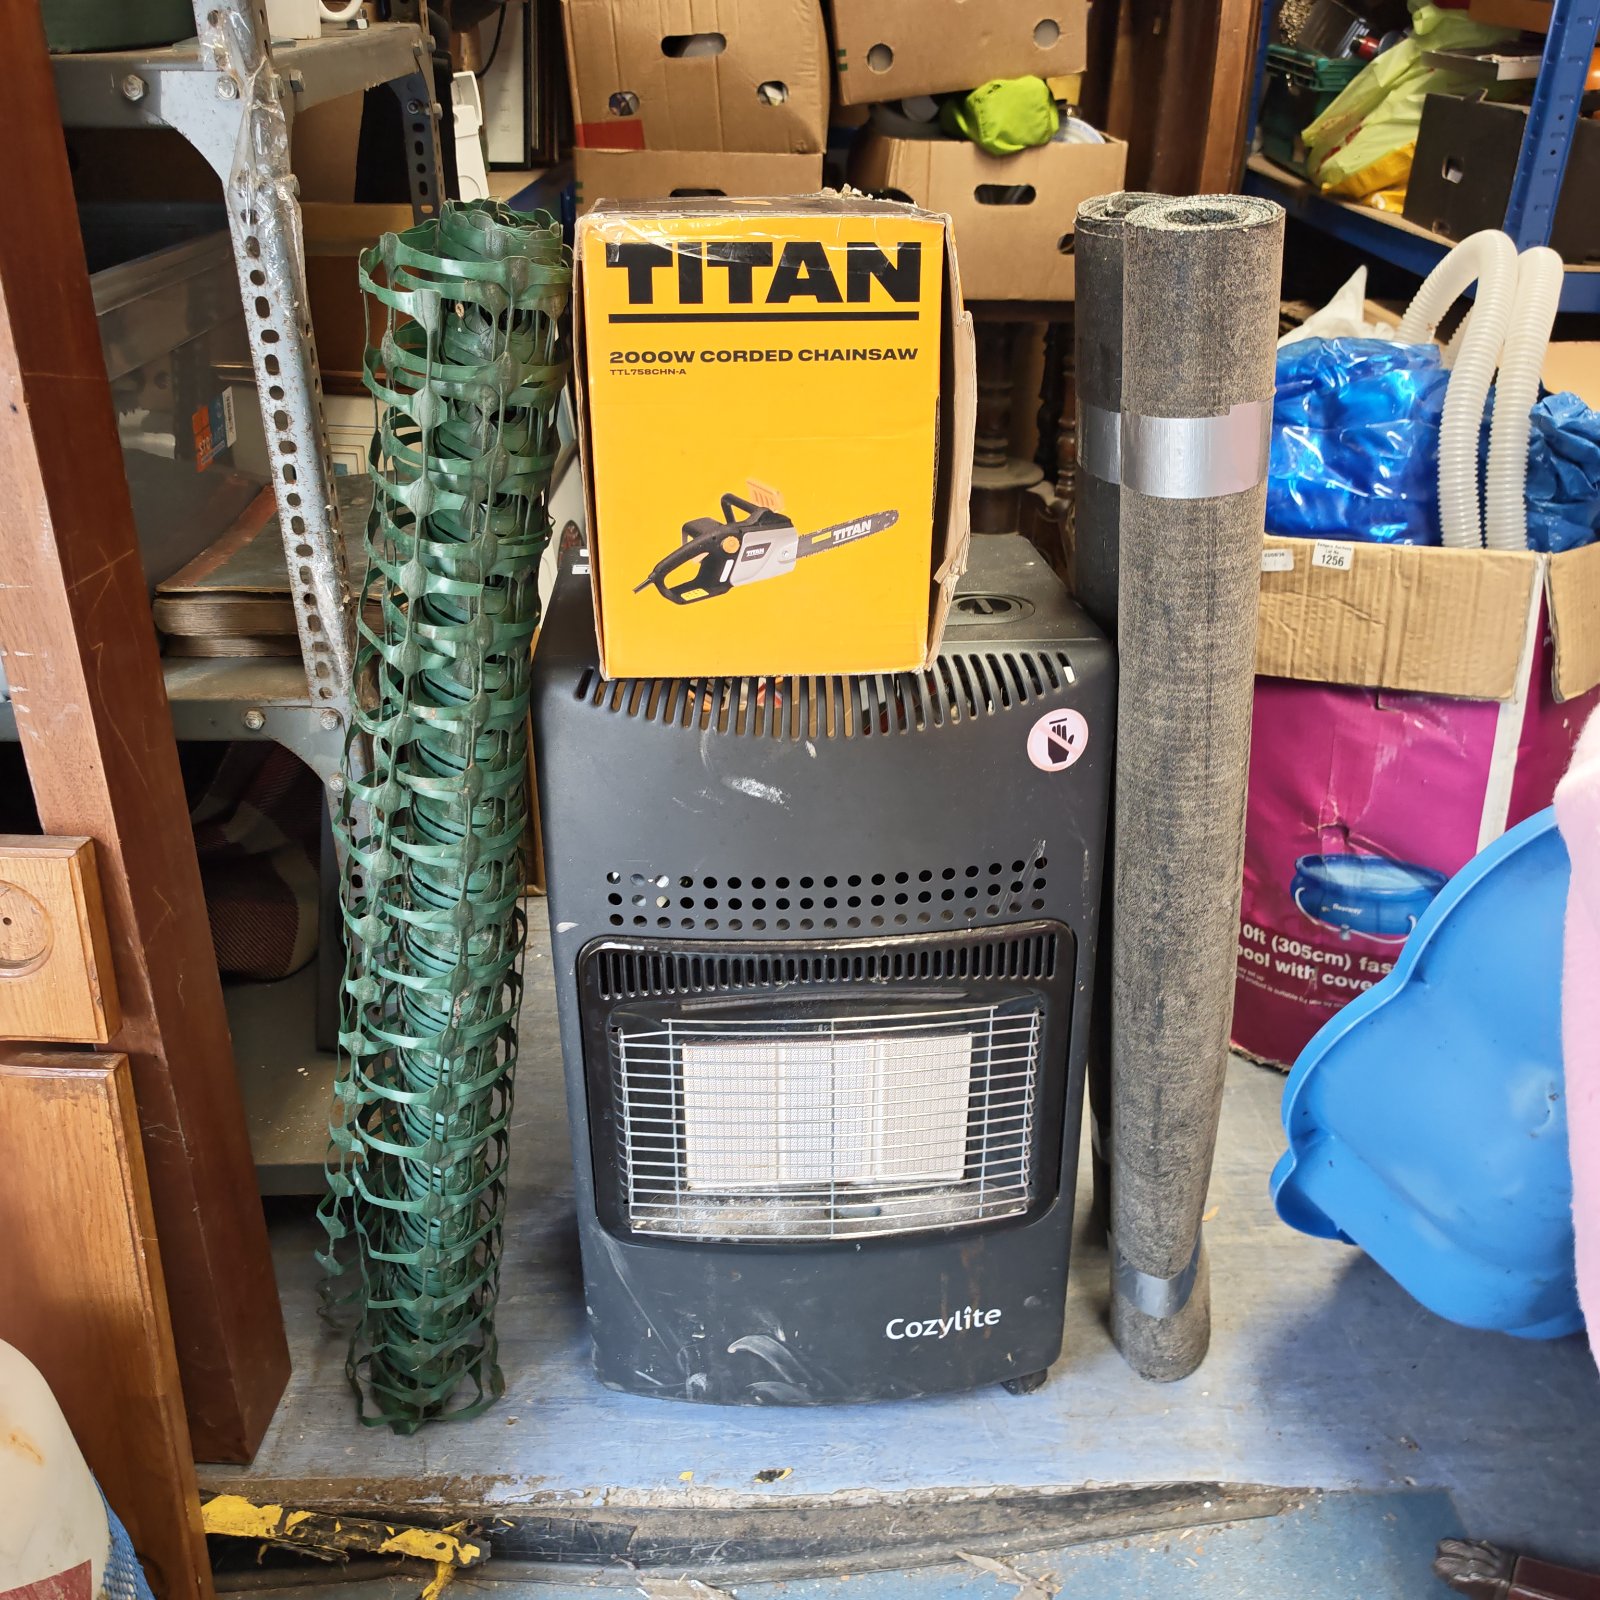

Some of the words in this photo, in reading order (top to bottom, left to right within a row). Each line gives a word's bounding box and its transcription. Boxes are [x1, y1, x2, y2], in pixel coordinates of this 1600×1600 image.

[605, 241, 922, 305] TITAN
[609, 350, 695, 364] 2000W
[699, 350, 793, 363] CORDED
[797, 348, 918, 362] CHAINSAW
[609, 368, 687, 376] TTL758CHN-A
[832, 519, 872, 542] TITAN
[1321, 554, 1344, 567] 1256
[1239, 922, 1266, 945] 0ft
[1271, 935, 1351, 971] (305cm)
[1359, 957, 1394, 974] fas
[1275, 960, 1318, 980] with
[1321, 973, 1378, 991] cove
